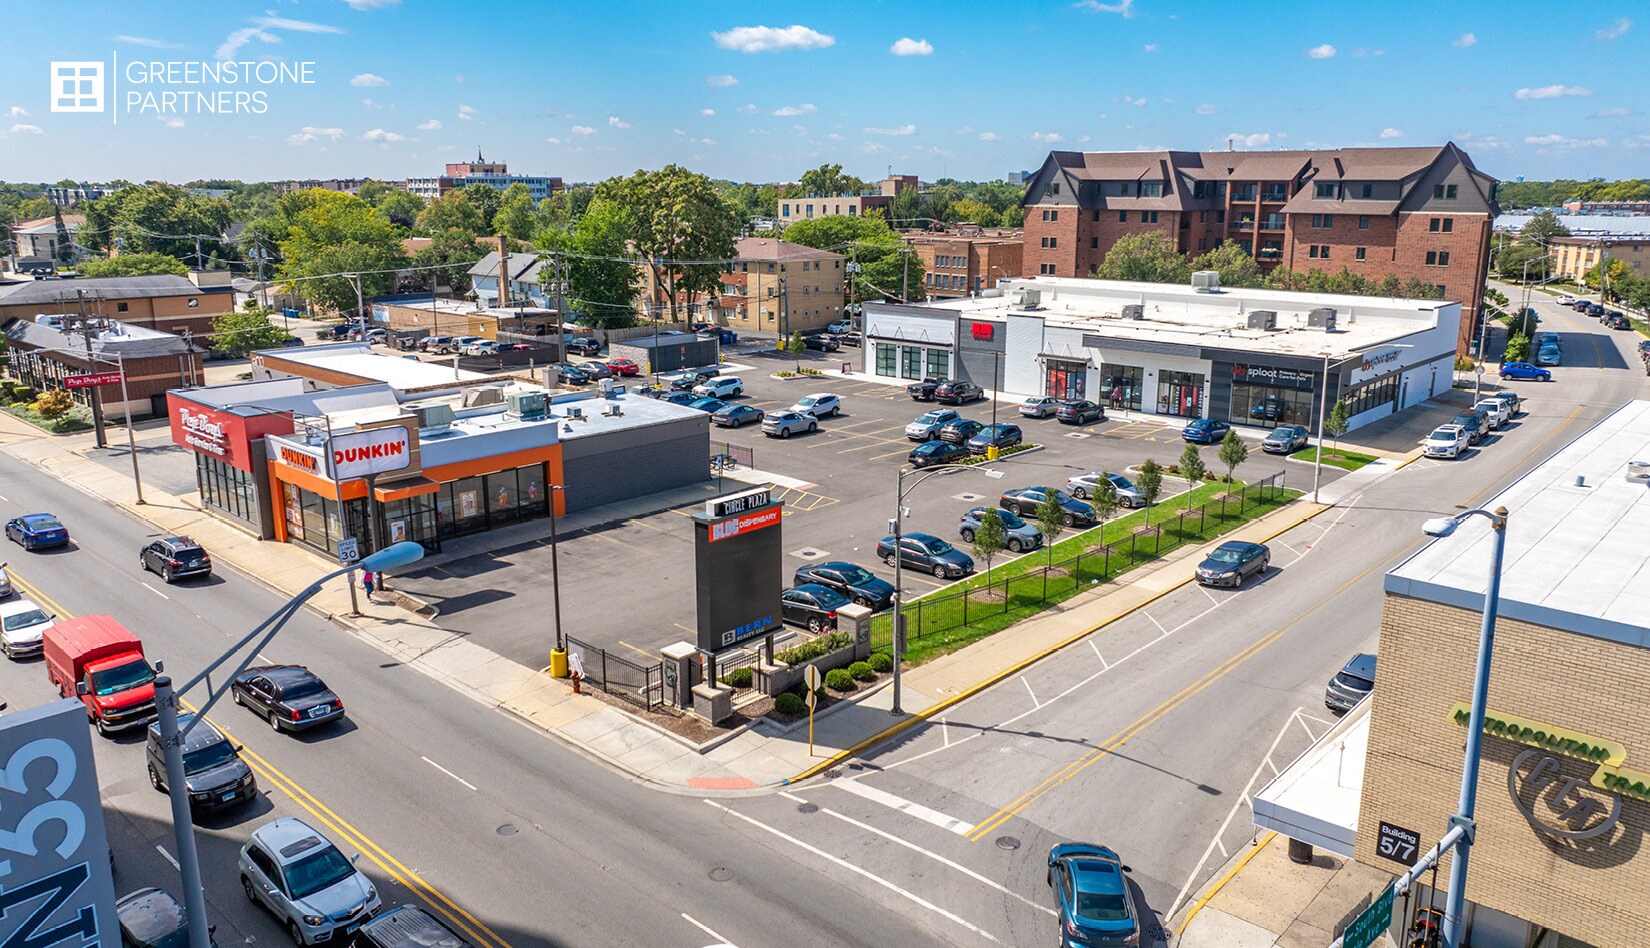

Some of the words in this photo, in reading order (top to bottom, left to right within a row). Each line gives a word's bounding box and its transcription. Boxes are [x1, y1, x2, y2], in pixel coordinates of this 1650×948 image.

[1248, 367, 1277, 378] sploot
[281, 447, 316, 469] DUNKIN'
[333, 440, 406, 465] DUNKIN'
[724, 499, 745, 515] CIRCLE
[748, 493, 767, 509] PLAZA
[739, 512, 777, 528] DISPENSARY
[341, 550, 357, 560] 30
[736, 615, 772, 636] BERN
[1454, 709, 1611, 762] MTROPOLITAN
[1602, 772, 1650, 798] TRA
[1382, 825, 1416, 844] Building
[1380, 836, 1415, 860] 5/7
